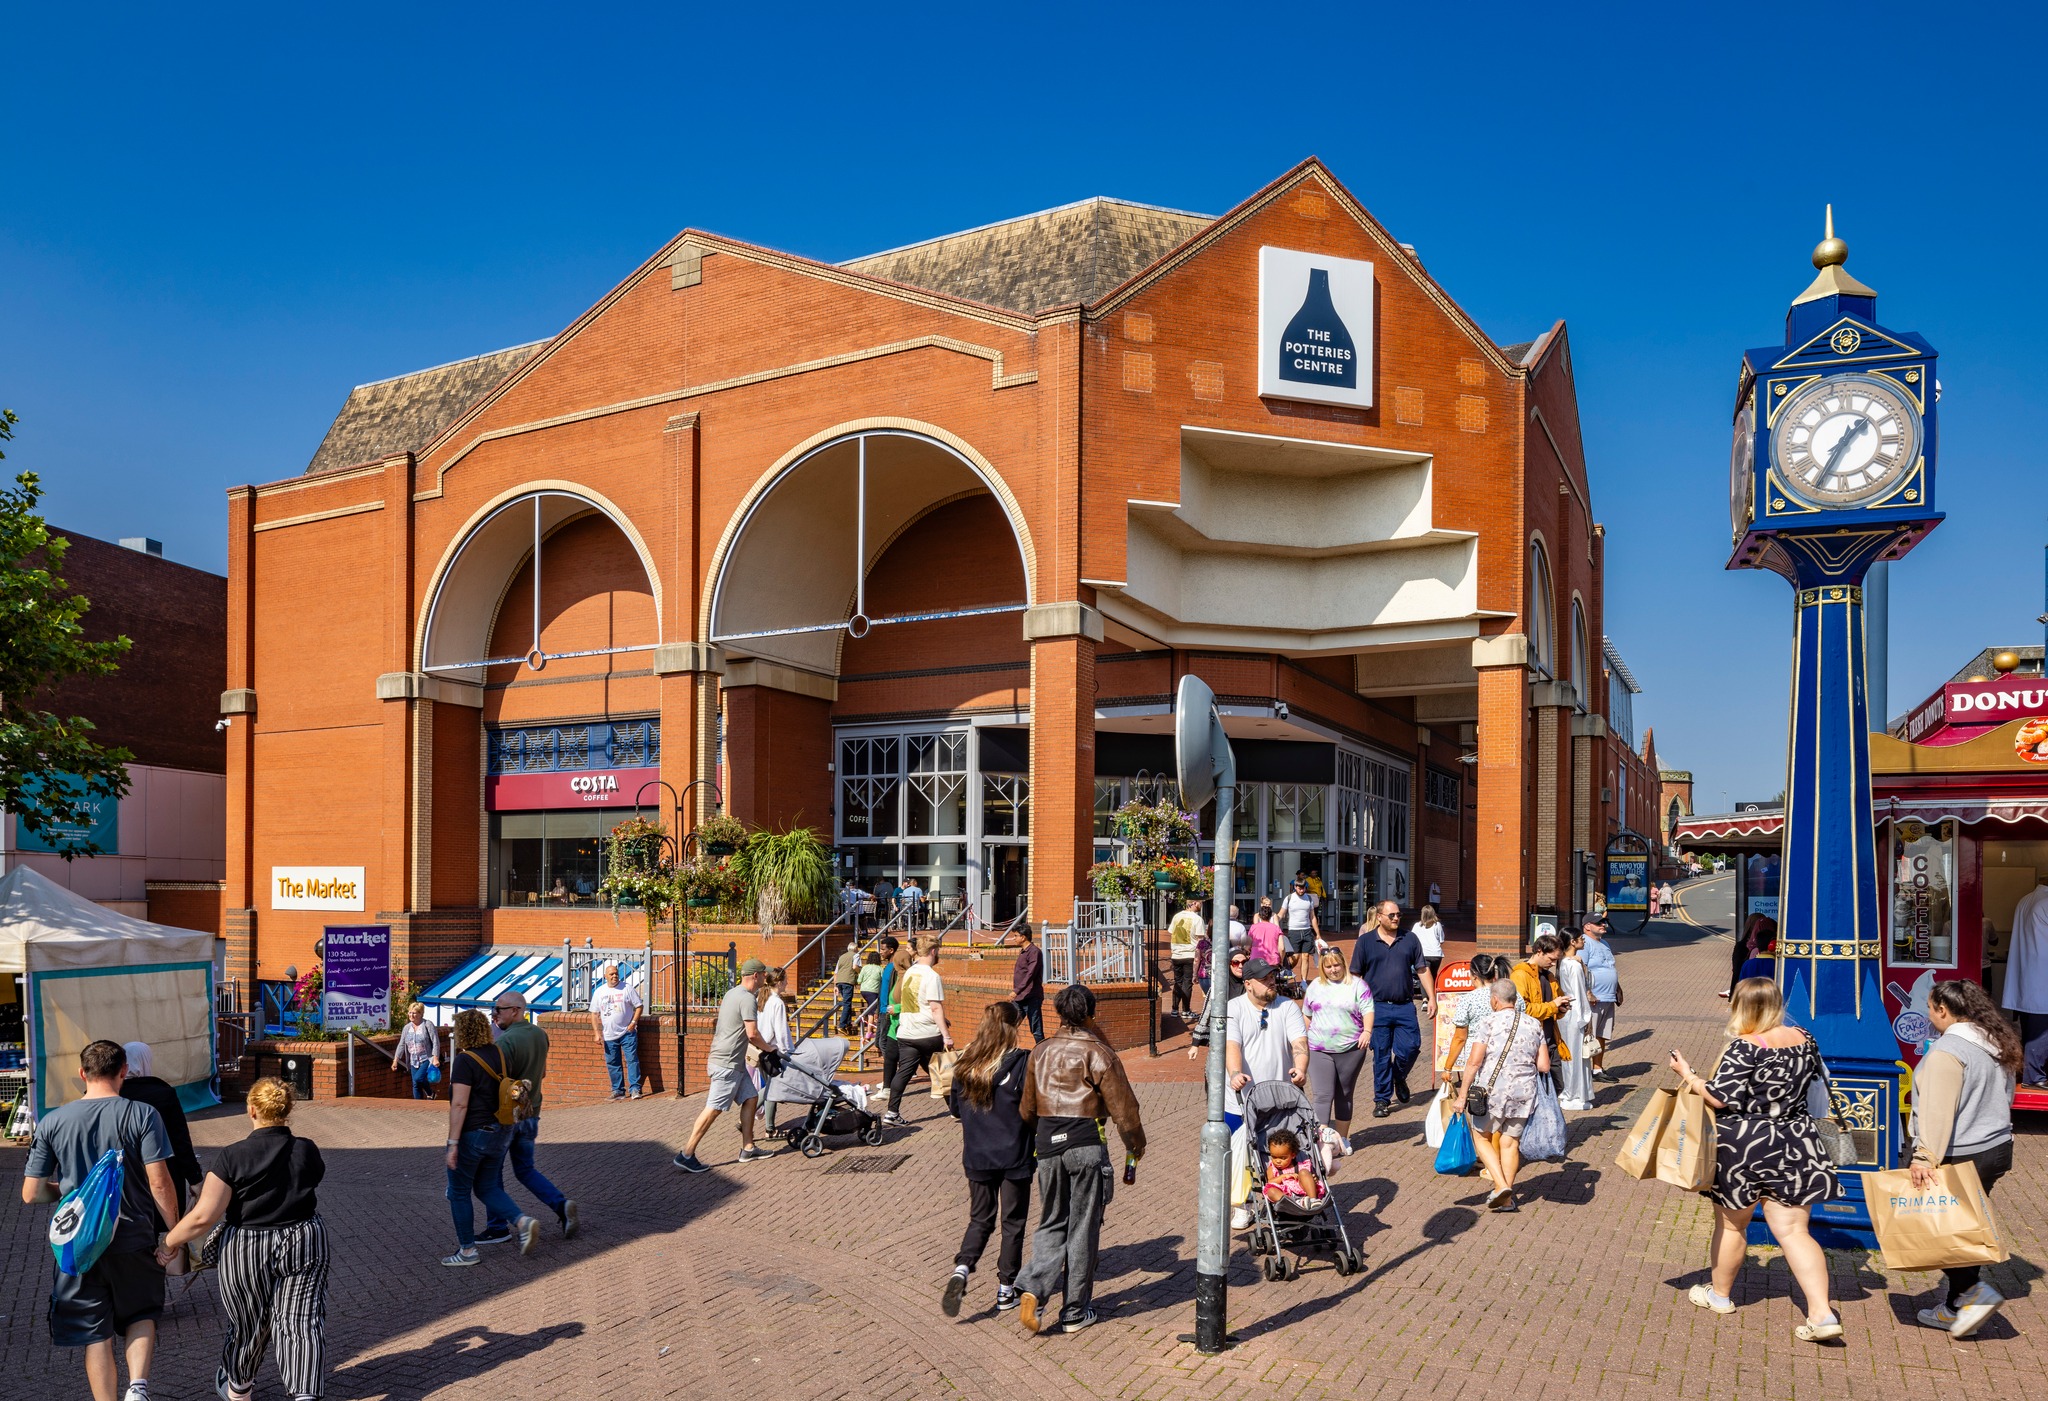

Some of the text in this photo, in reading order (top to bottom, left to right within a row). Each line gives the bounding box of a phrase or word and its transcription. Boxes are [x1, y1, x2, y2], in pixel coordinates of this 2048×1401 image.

[1307, 329, 1331, 342] THE
[1285, 341, 1351, 361] POTTERIES
[1294, 358, 1343, 375] CENTRE
[1951, 690, 2048, 712] DONU
[571, 775, 618, 793] COSTA
[849, 815, 869, 824] COFFE
[278, 877, 357, 899] The Market
[1913, 855, 1929, 958] COFFEE
[327, 932, 387, 947] Market
[1452, 968, 1471, 978] Min
[1445, 978, 1474, 988] Donu
[328, 1002, 387, 1017] market
[1898, 1021, 1926, 1033] Fake
[1890, 1195, 1960, 1208] PRIMARK
